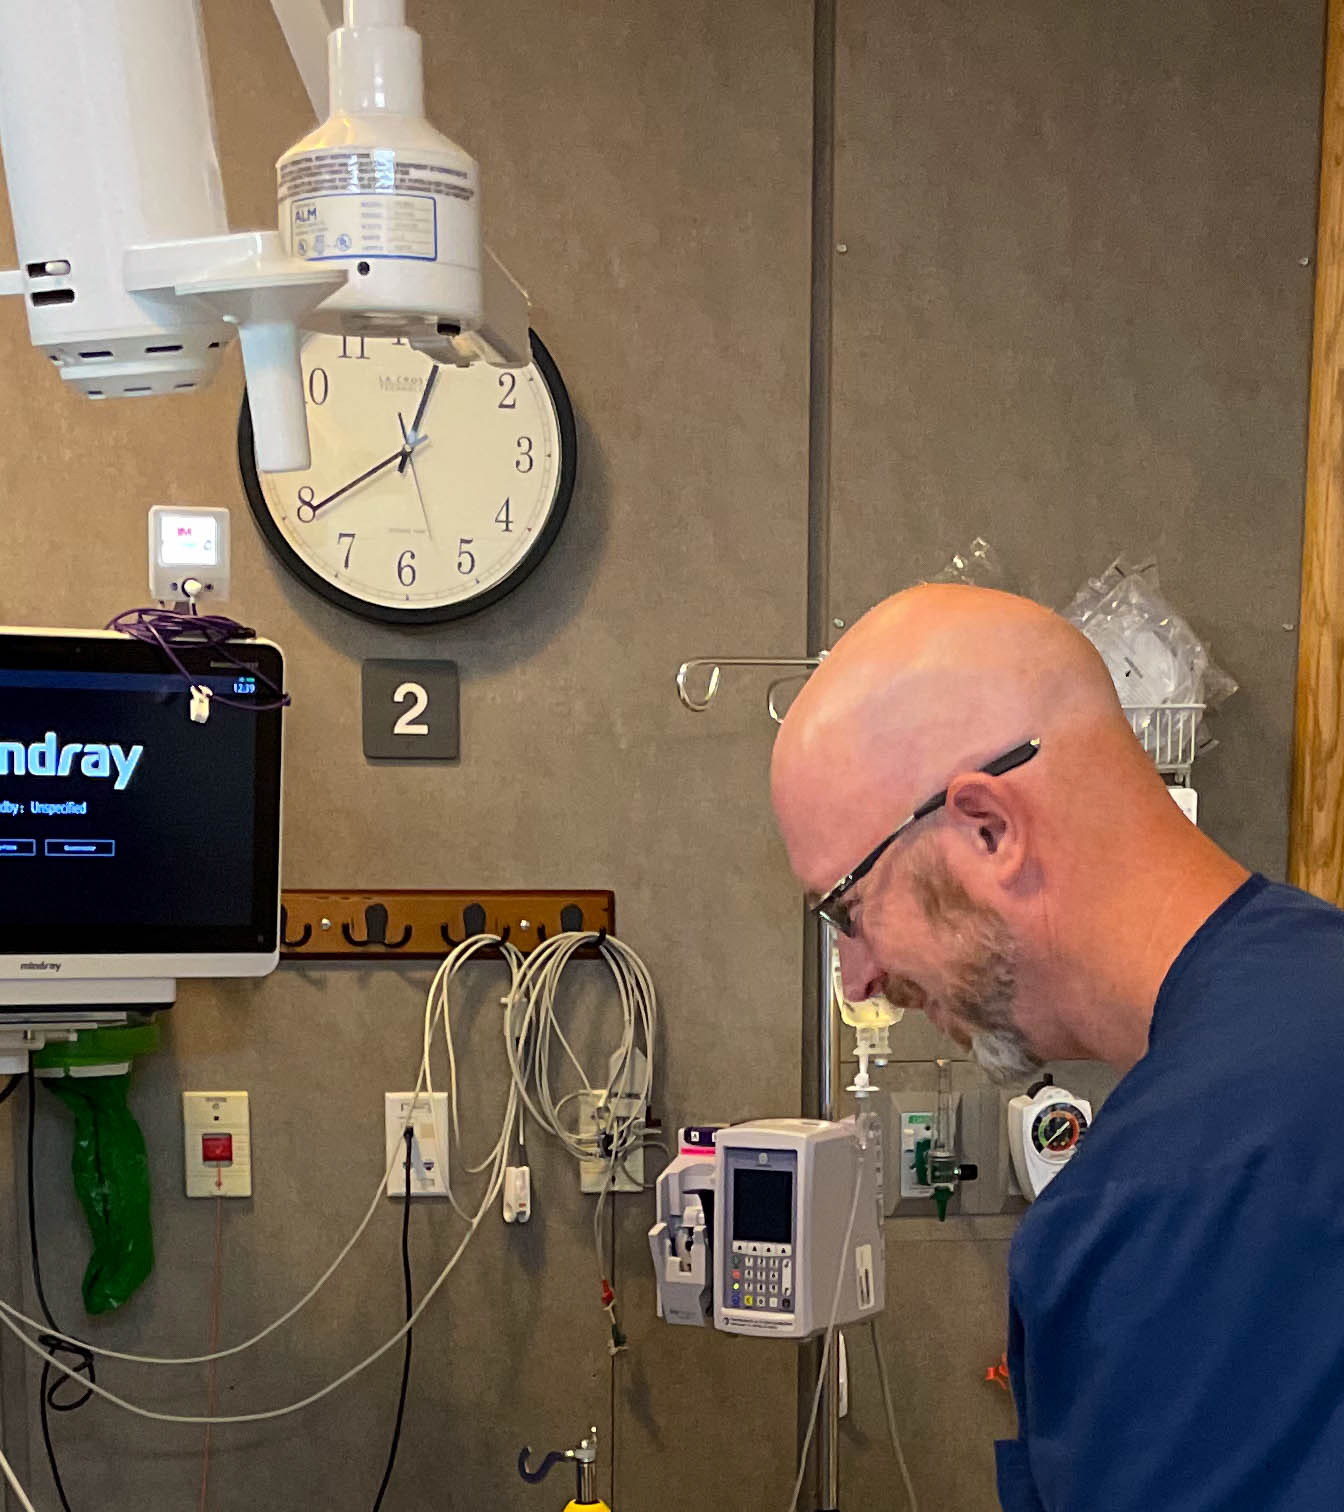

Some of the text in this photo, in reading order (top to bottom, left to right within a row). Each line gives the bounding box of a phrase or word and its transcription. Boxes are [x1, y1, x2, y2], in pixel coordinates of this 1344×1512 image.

[295, 208, 317, 223] ALM
[309, 367, 329, 405] 0
[498, 372, 517, 409] 2
[515, 436, 534, 473] 3
[297, 486, 317, 523] 8
[495, 497, 514, 533] 4
[337, 532, 357, 571] 7
[397, 550, 417, 587] 6
[457, 538, 476, 575] 5
[392, 682, 429, 735] 2
[30, 801, 87, 816] Unspecified
[20, 961, 62, 973] mindray
